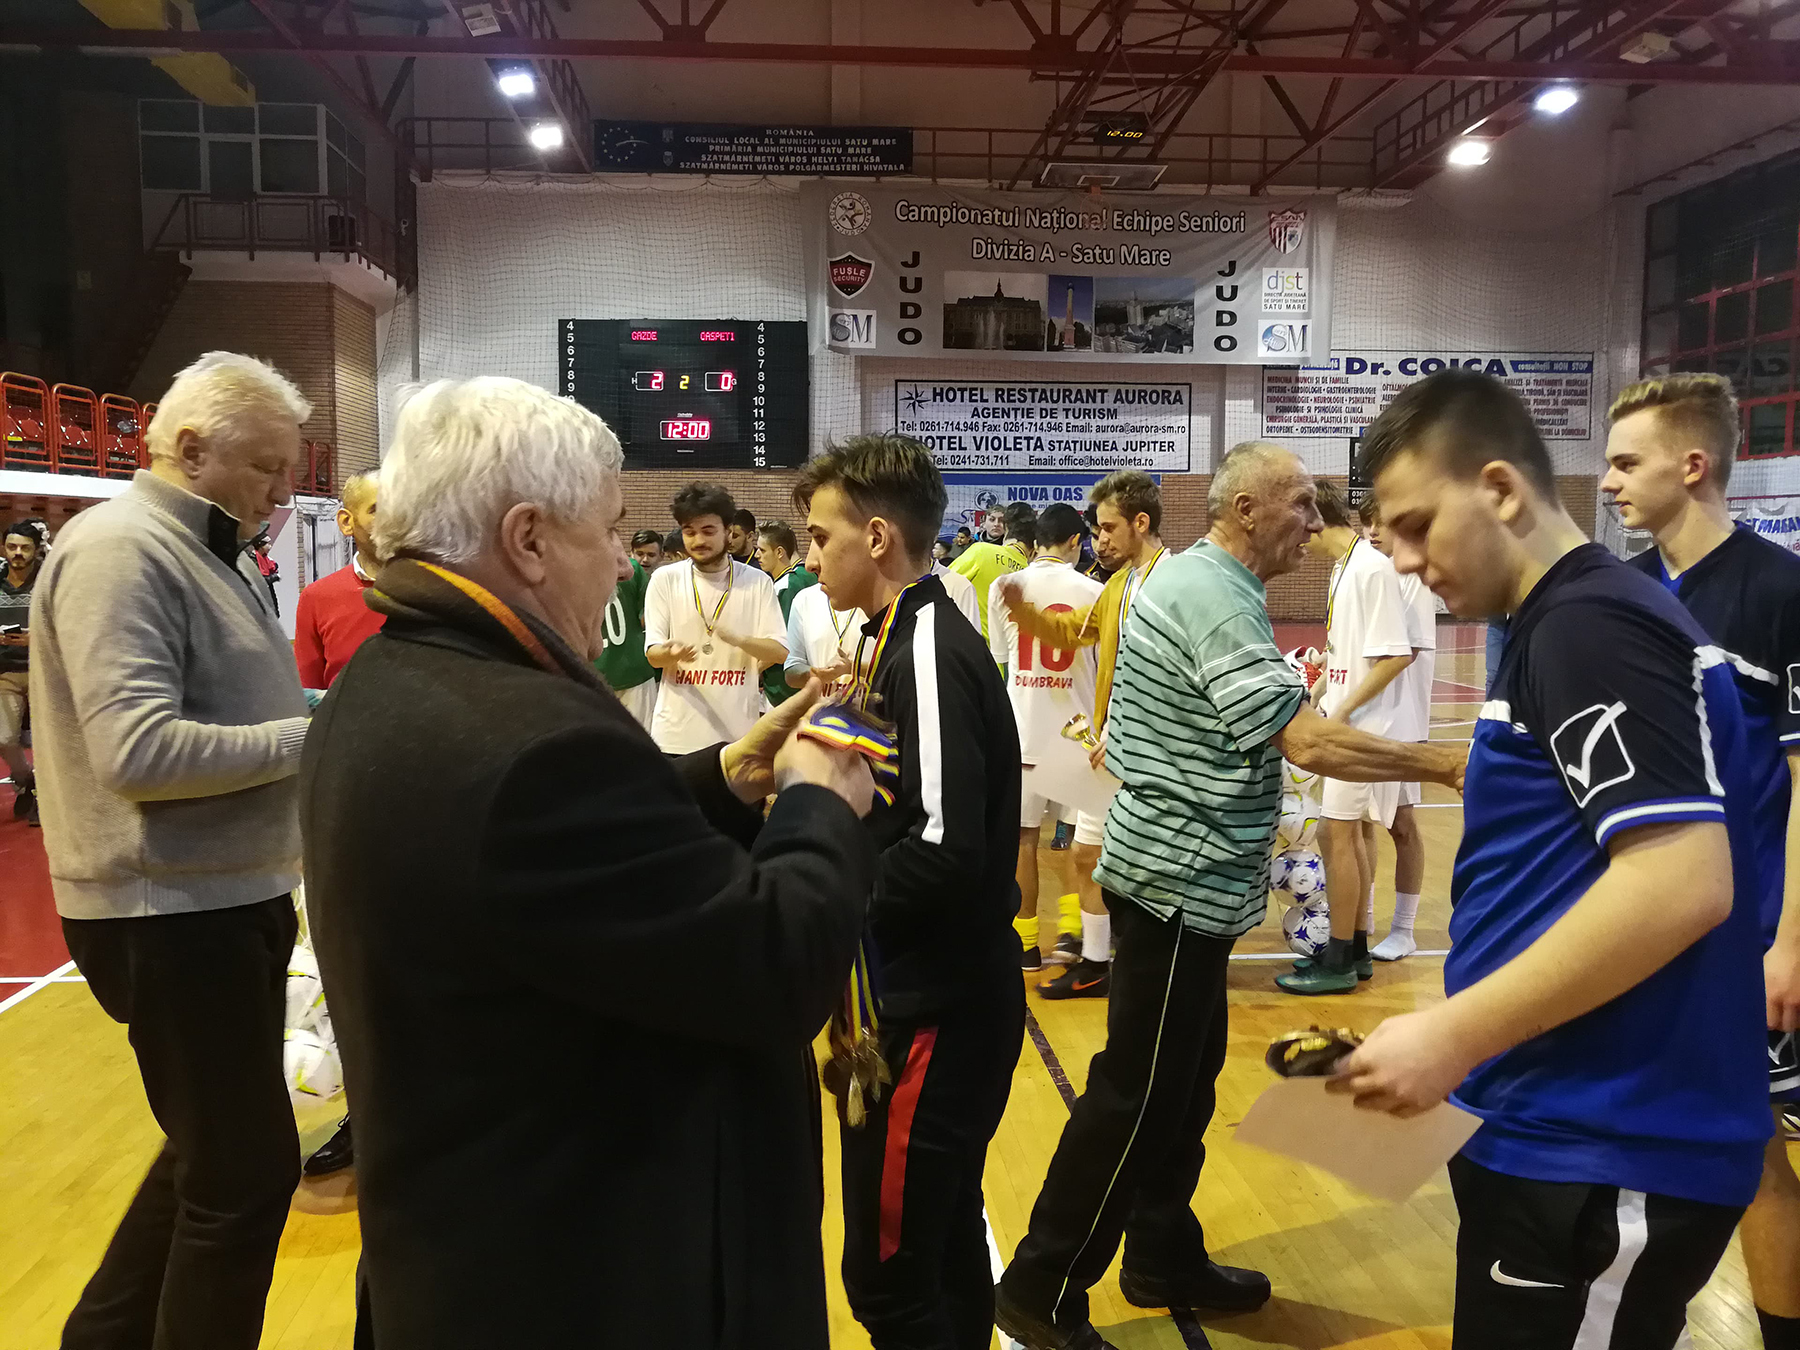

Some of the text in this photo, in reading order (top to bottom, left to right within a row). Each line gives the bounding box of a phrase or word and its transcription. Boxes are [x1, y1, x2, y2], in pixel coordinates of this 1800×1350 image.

[685, 136, 729, 144] CONSILIUL
[779, 138, 841, 146] MUNICIPIULUI
[845, 138, 868, 146] SATU
[872, 138, 897, 146] MARE
[757, 146, 817, 154] MUNICIPIULUI
[821, 146, 843, 154] SATU
[779, 155, 807, 163] VÁROS
[841, 155, 881, 163] TANÁCSA
[757, 162, 785, 171] VÁROS
[789, 163, 860, 171] POLGÁRMESTERI
[895, 200, 1020, 228] Campionatul
[1112, 209, 1174, 236] Echipe
[1179, 211, 1245, 233] Seniori
[972, 237, 1035, 262] Divizia
[1039, 242, 1055, 262] A
[1071, 242, 1115, 264] Satu
[1120, 244, 1171, 266] Mare
[834, 275, 866, 283] SECURITY
[1267, 270, 1304, 294] djst
[897, 251, 923, 345] JUDO
[1213, 260, 1239, 352] JUDO
[566, 321, 575, 331] 4
[757, 322, 765, 332] 4
[566, 333, 575, 342] 5
[631, 331, 657, 341] GAZDE
[757, 334, 765, 344] 5
[567, 346, 575, 355] 6
[757, 347, 765, 357] 6
[567, 358, 575, 367] 7
[757, 359, 765, 369] 7
[1345, 357, 1391, 376] Dr.
[1572, 361, 1588, 371] STOP
[567, 371, 575, 380] 8
[757, 371, 765, 381] 8
[651, 373, 663, 389] 2
[679, 375, 689, 390] 2
[720, 374, 732, 390] 0
[567, 382, 575, 392] 9
[757, 384, 765, 393] 9
[1290, 386, 1322, 394] CARDIOLOGIE
[1326, 386, 1376, 394] GASTROENTEROLOGIE
[752, 396, 765, 406] 10
[932, 387, 1183, 405] HOTEL RESTAURANT AURORA
[753, 408, 764, 418] 11
[971, 407, 1118, 421] AGENȚIE DE TURISM
[667, 423, 710, 439] 12:00
[753, 421, 765, 431] 12
[901, 421, 917, 431] Tel:
[920, 421, 979, 432] 0261-714.946
[982, 422, 1001, 432] Fax:
[1003, 422, 1063, 433] 0261-714.946
[1065, 422, 1093, 433] Email:
[753, 432, 766, 442] 13
[972, 435, 1044, 452] VIOLETA
[1048, 440, 1119, 454] STAȚIUNEA
[1121, 440, 1175, 452] JUPITER
[753, 445, 766, 455] 14
[753, 457, 766, 467] 15
[932, 454, 1154, 467] Tel: 0241-731.711 Email: office@hotelvioleta.ro
[1007, 487, 1083, 501] NOVA OAS
[995, 554, 1006, 566] FC
[1015, 675, 1073, 690] DUMBRAVA
